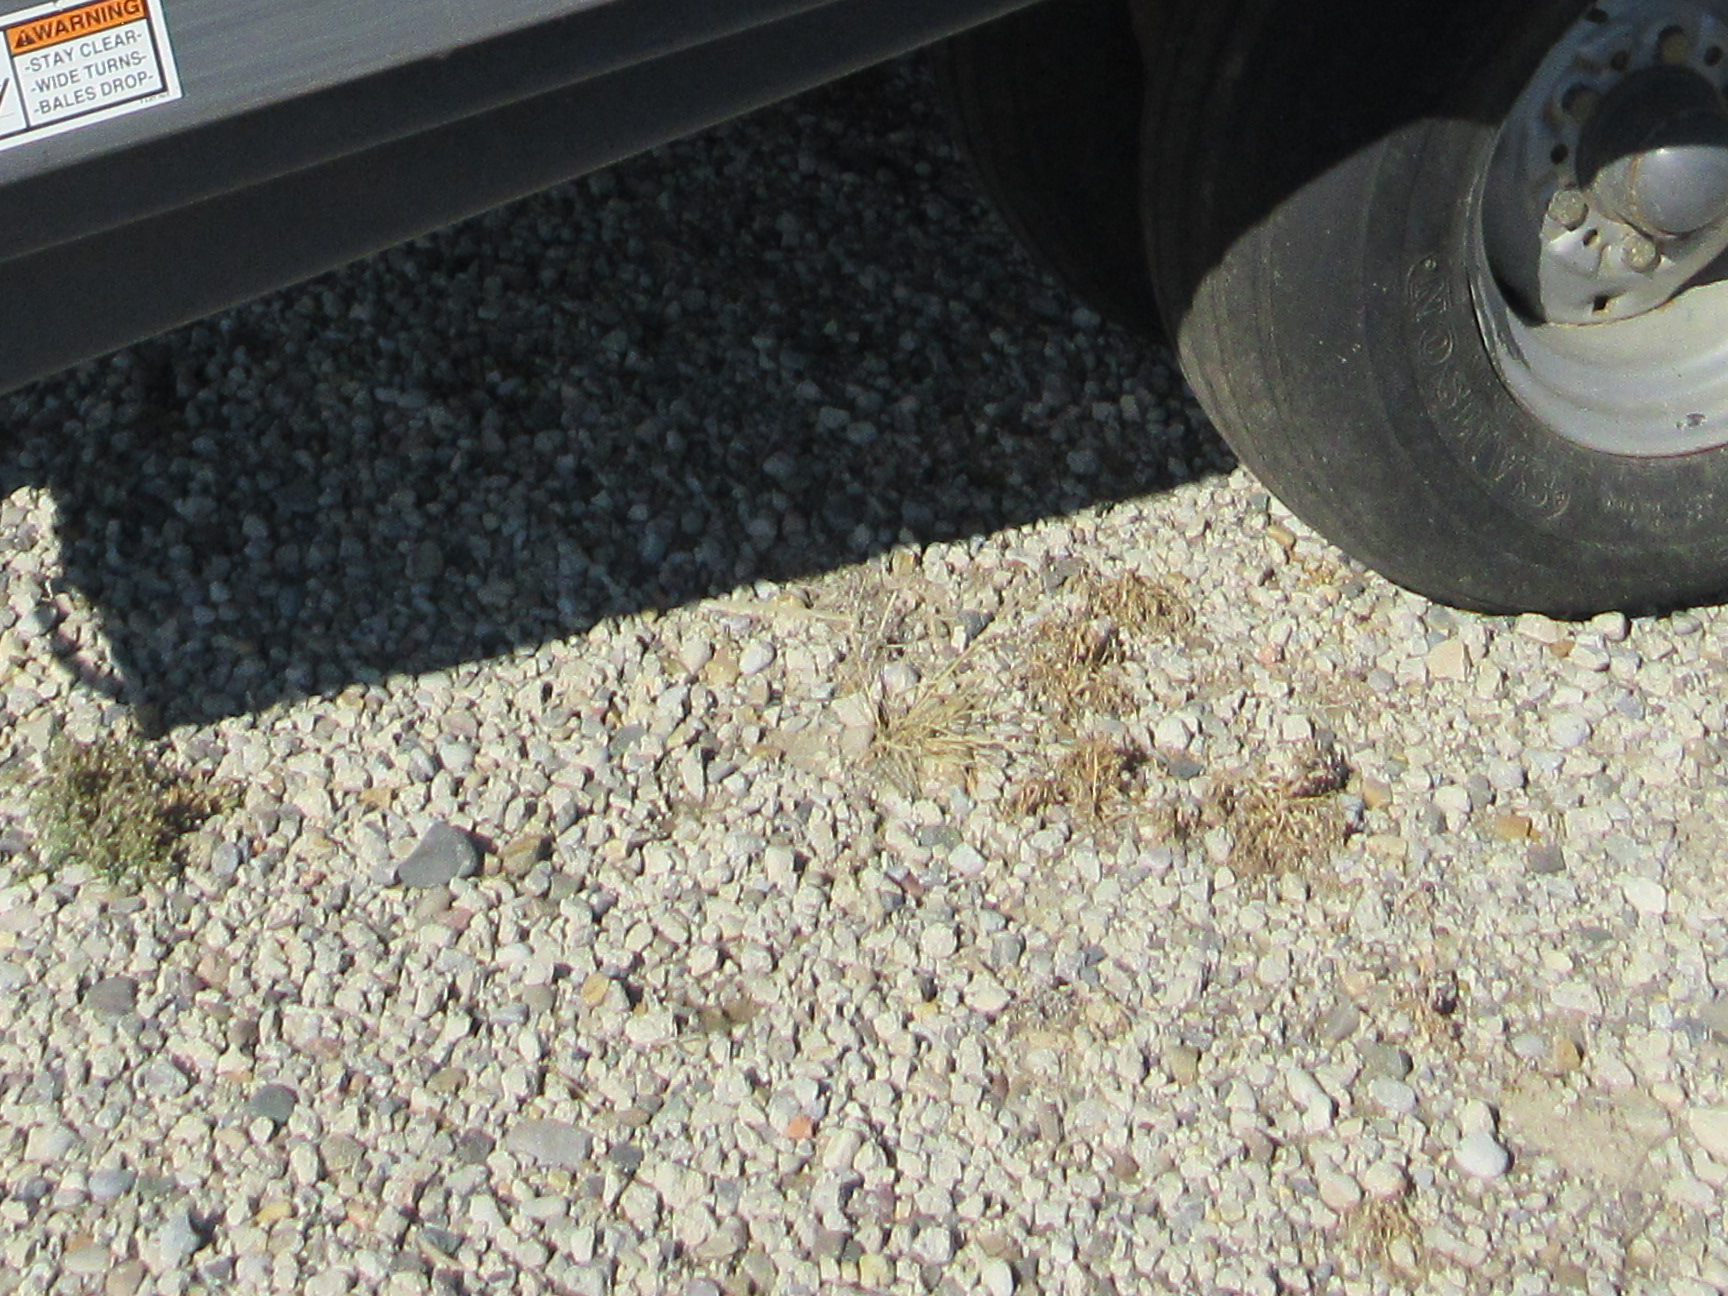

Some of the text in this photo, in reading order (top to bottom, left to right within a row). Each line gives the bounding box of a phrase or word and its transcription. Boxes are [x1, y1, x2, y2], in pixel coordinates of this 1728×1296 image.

[25, 29, 143, 73] -STAY CLEAR-
[30, 50, 148, 94] -WIDE TURNS-
[34, 70, 154, 115] -BALES DROP-
